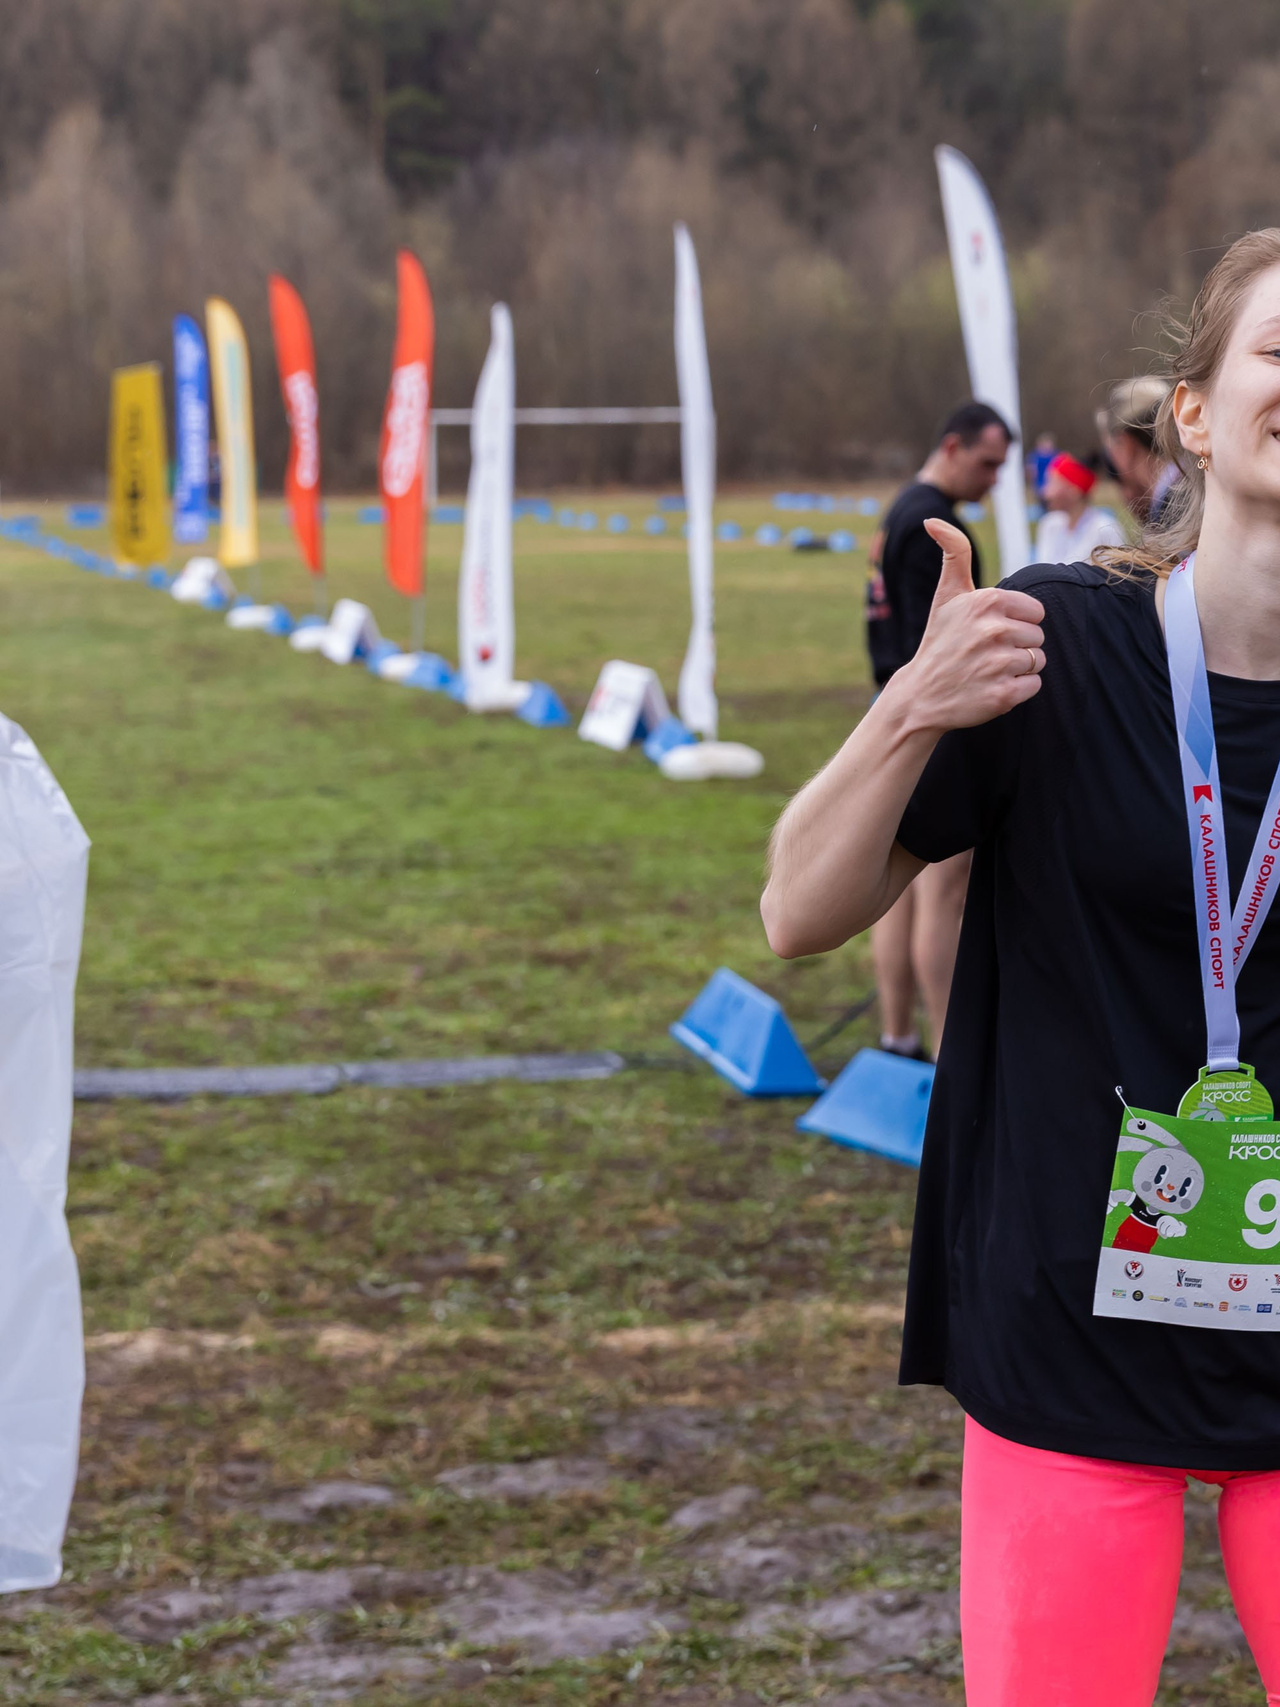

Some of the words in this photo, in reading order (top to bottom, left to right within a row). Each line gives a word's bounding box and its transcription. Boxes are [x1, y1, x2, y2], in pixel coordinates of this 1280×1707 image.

[1200, 814, 1220, 932] КАЛАШНИКОВ
[1209, 936, 1225, 990] СПОРТ
[1203, 1082, 1235, 1090] КАЛАШНИКОВ
[1235, 1081, 1252, 1089] СПОРТ
[1202, 1090, 1252, 1103] КРОСС
[1231, 1134, 1275, 1143] КАЛАШНИКОВ
